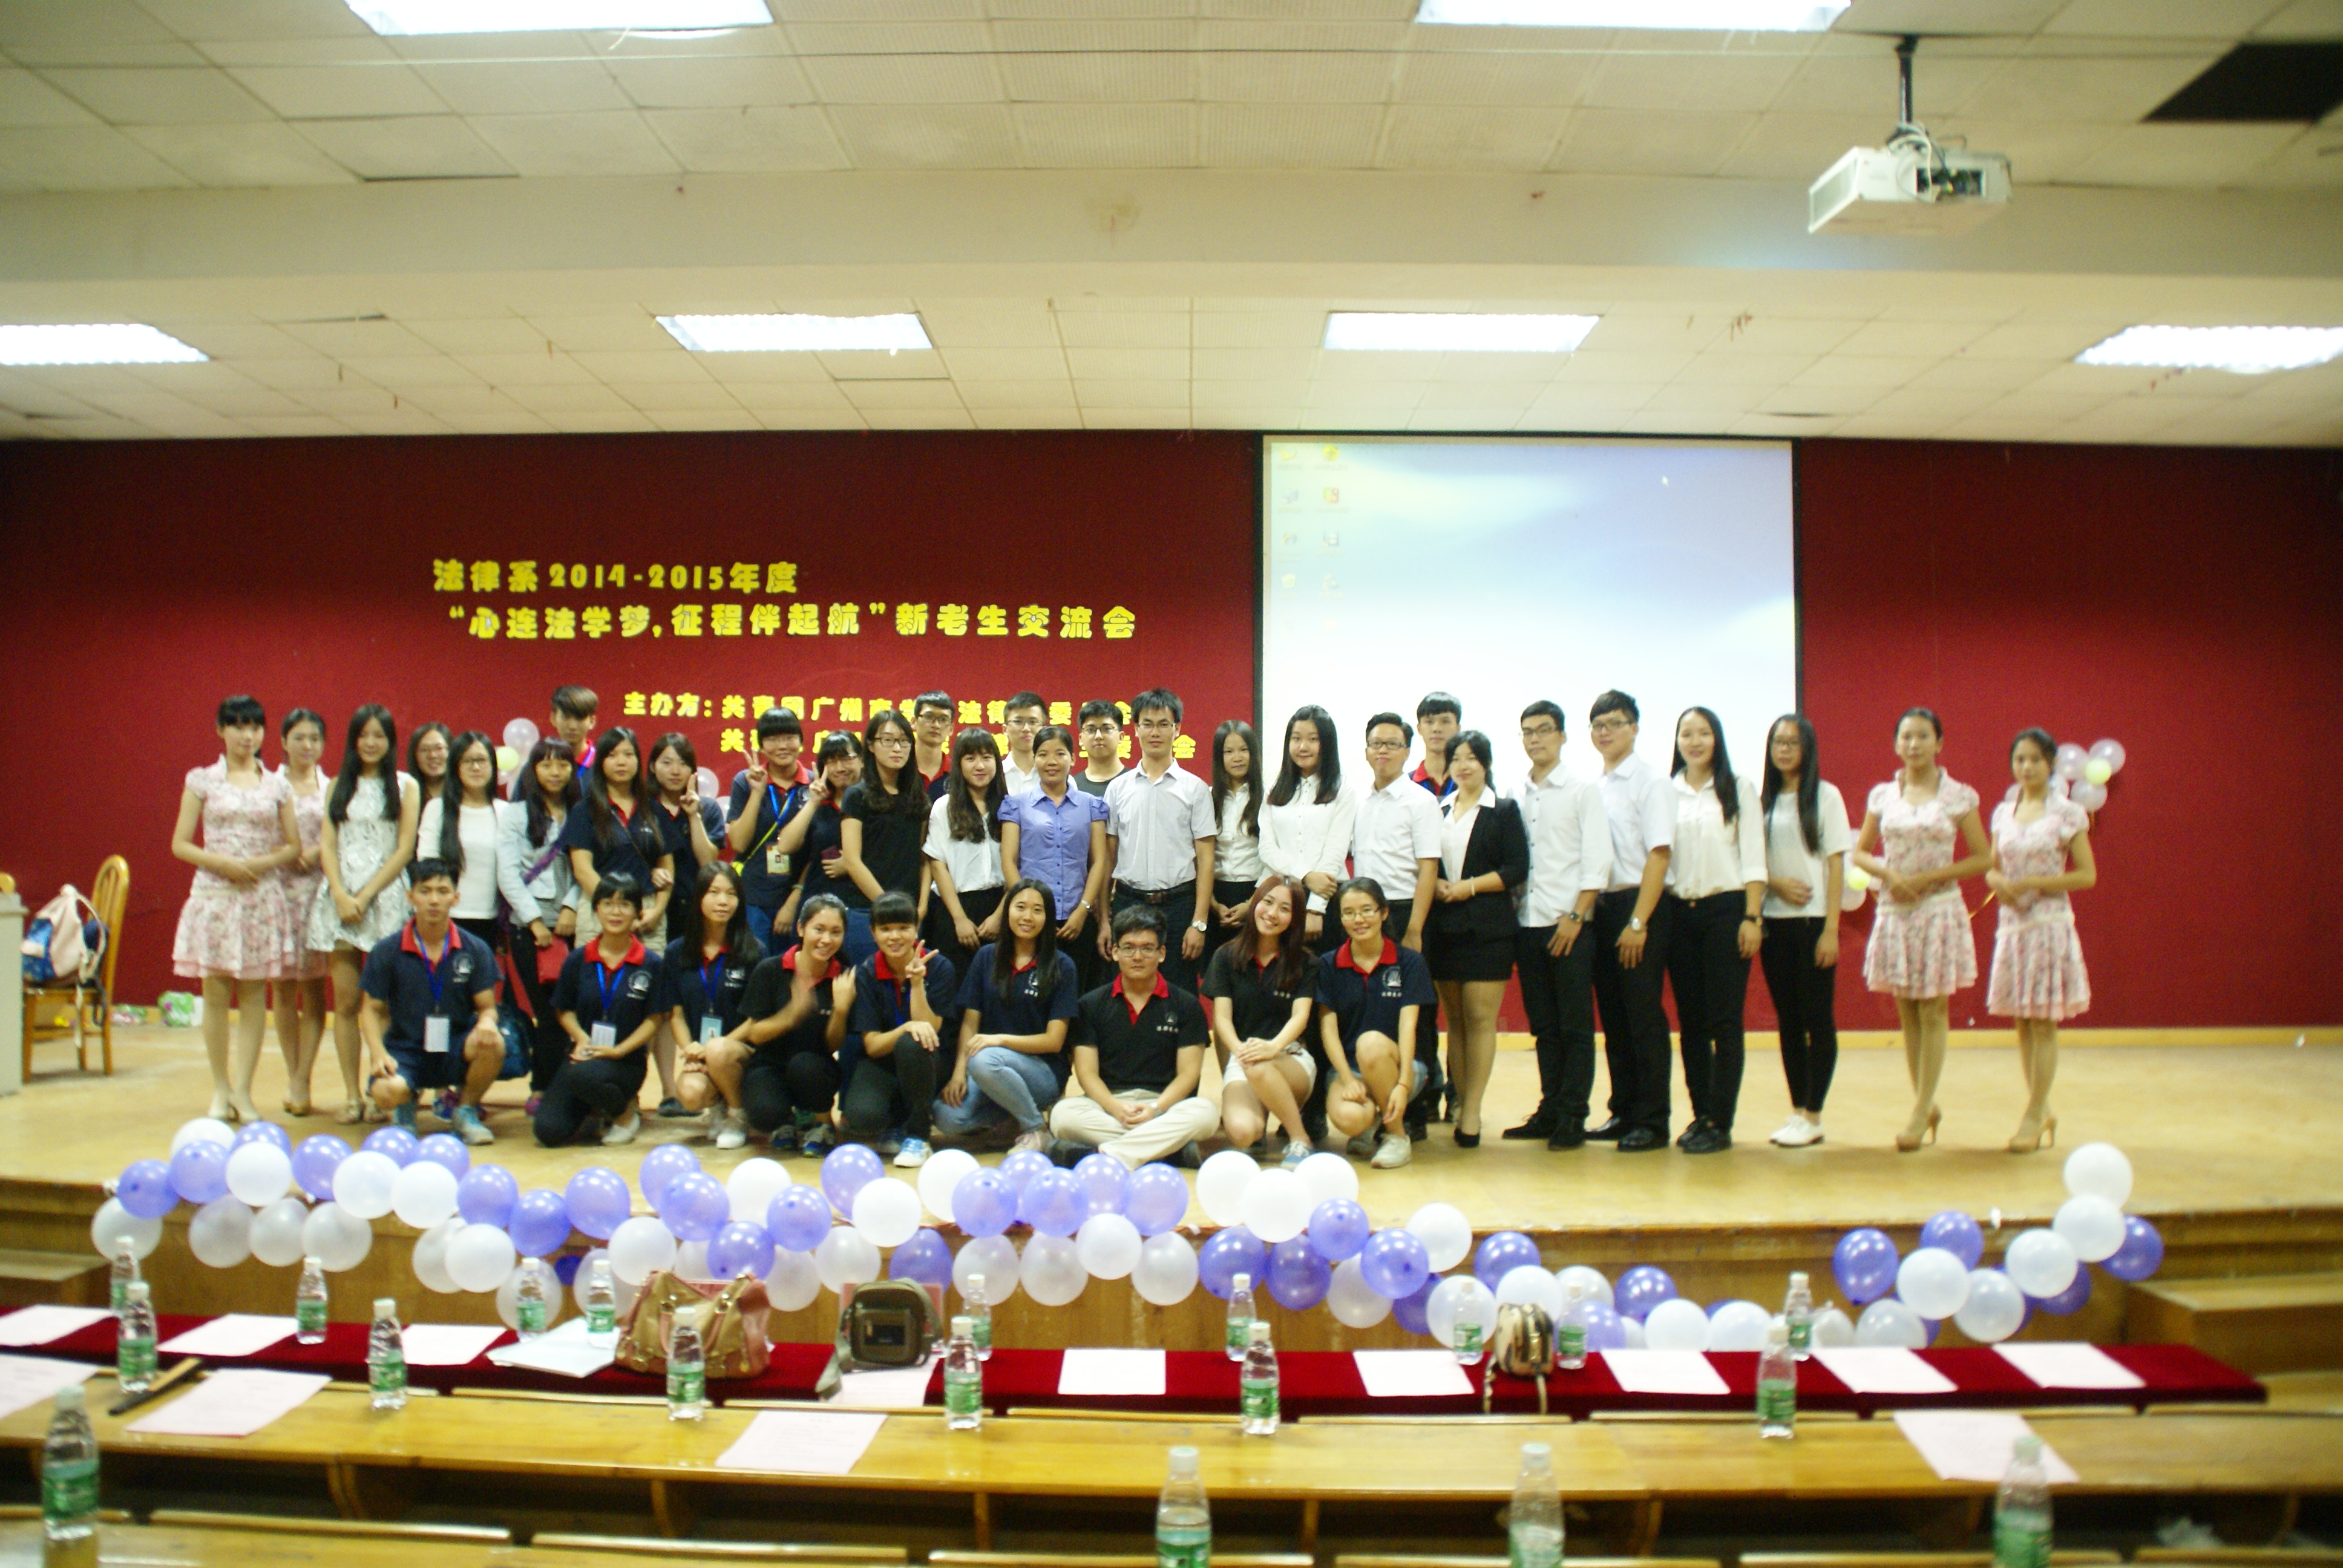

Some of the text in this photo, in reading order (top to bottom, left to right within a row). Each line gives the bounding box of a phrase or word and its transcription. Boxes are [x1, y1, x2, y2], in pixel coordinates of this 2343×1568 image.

[433, 558, 798, 594] 法律系2014-2015年度
